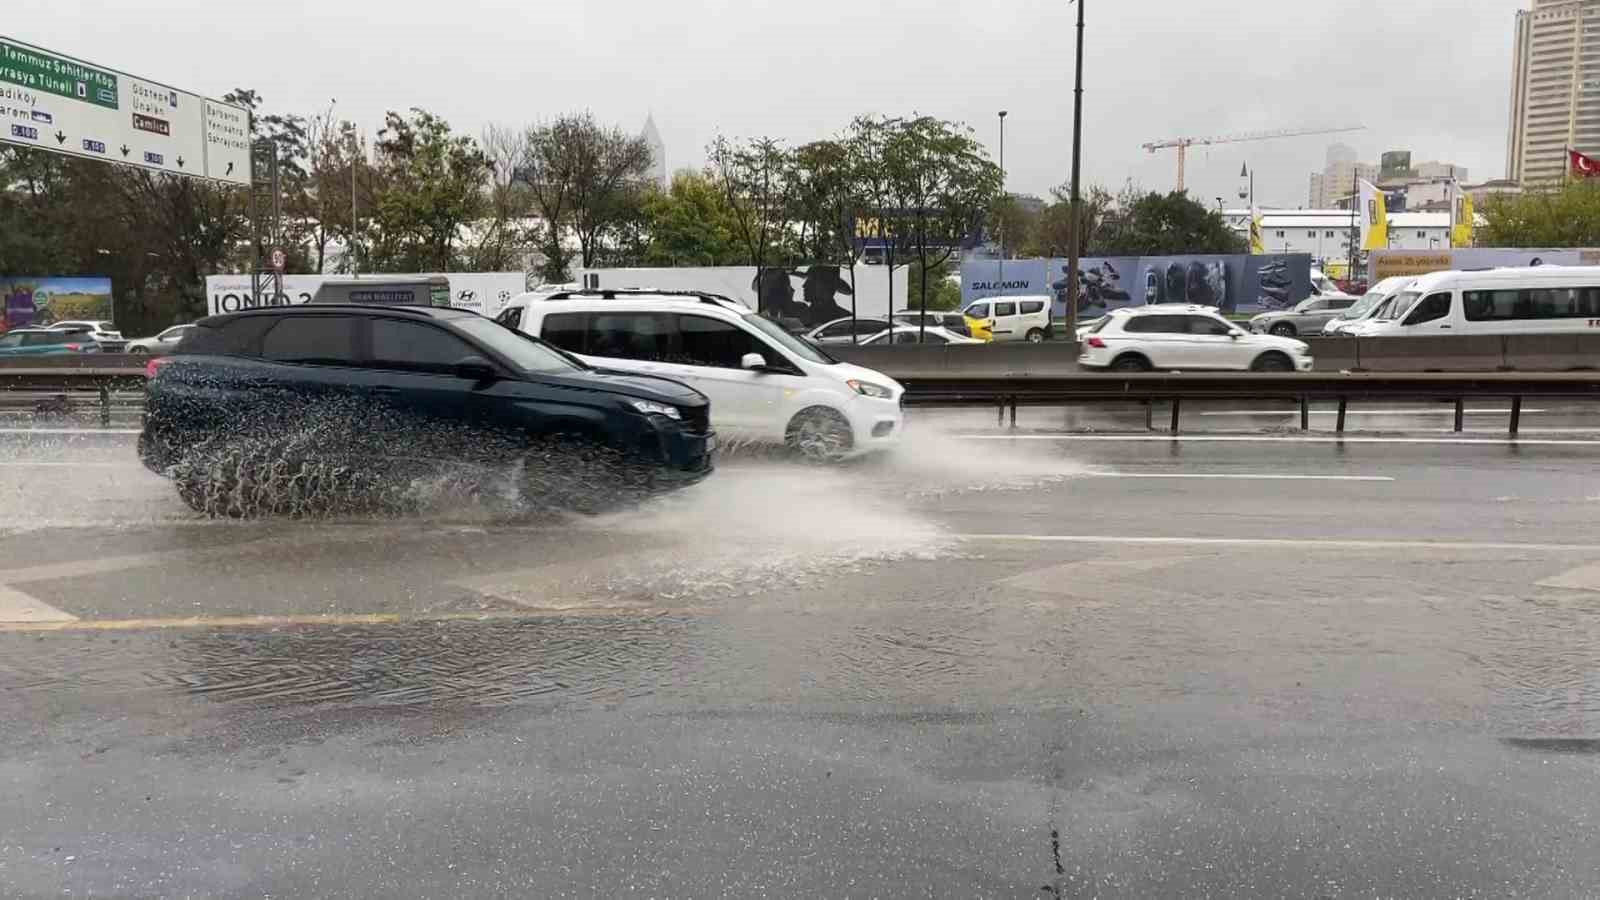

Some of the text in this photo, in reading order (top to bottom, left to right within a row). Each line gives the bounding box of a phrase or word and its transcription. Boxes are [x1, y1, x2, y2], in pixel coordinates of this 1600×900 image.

[3, 45, 51, 69] Temmuz
[0, 66, 35, 84] vrasya
[0, 88, 37, 106] adıköy
[0, 105, 30, 120] arem
[971, 280, 1029, 290] SALOMON
